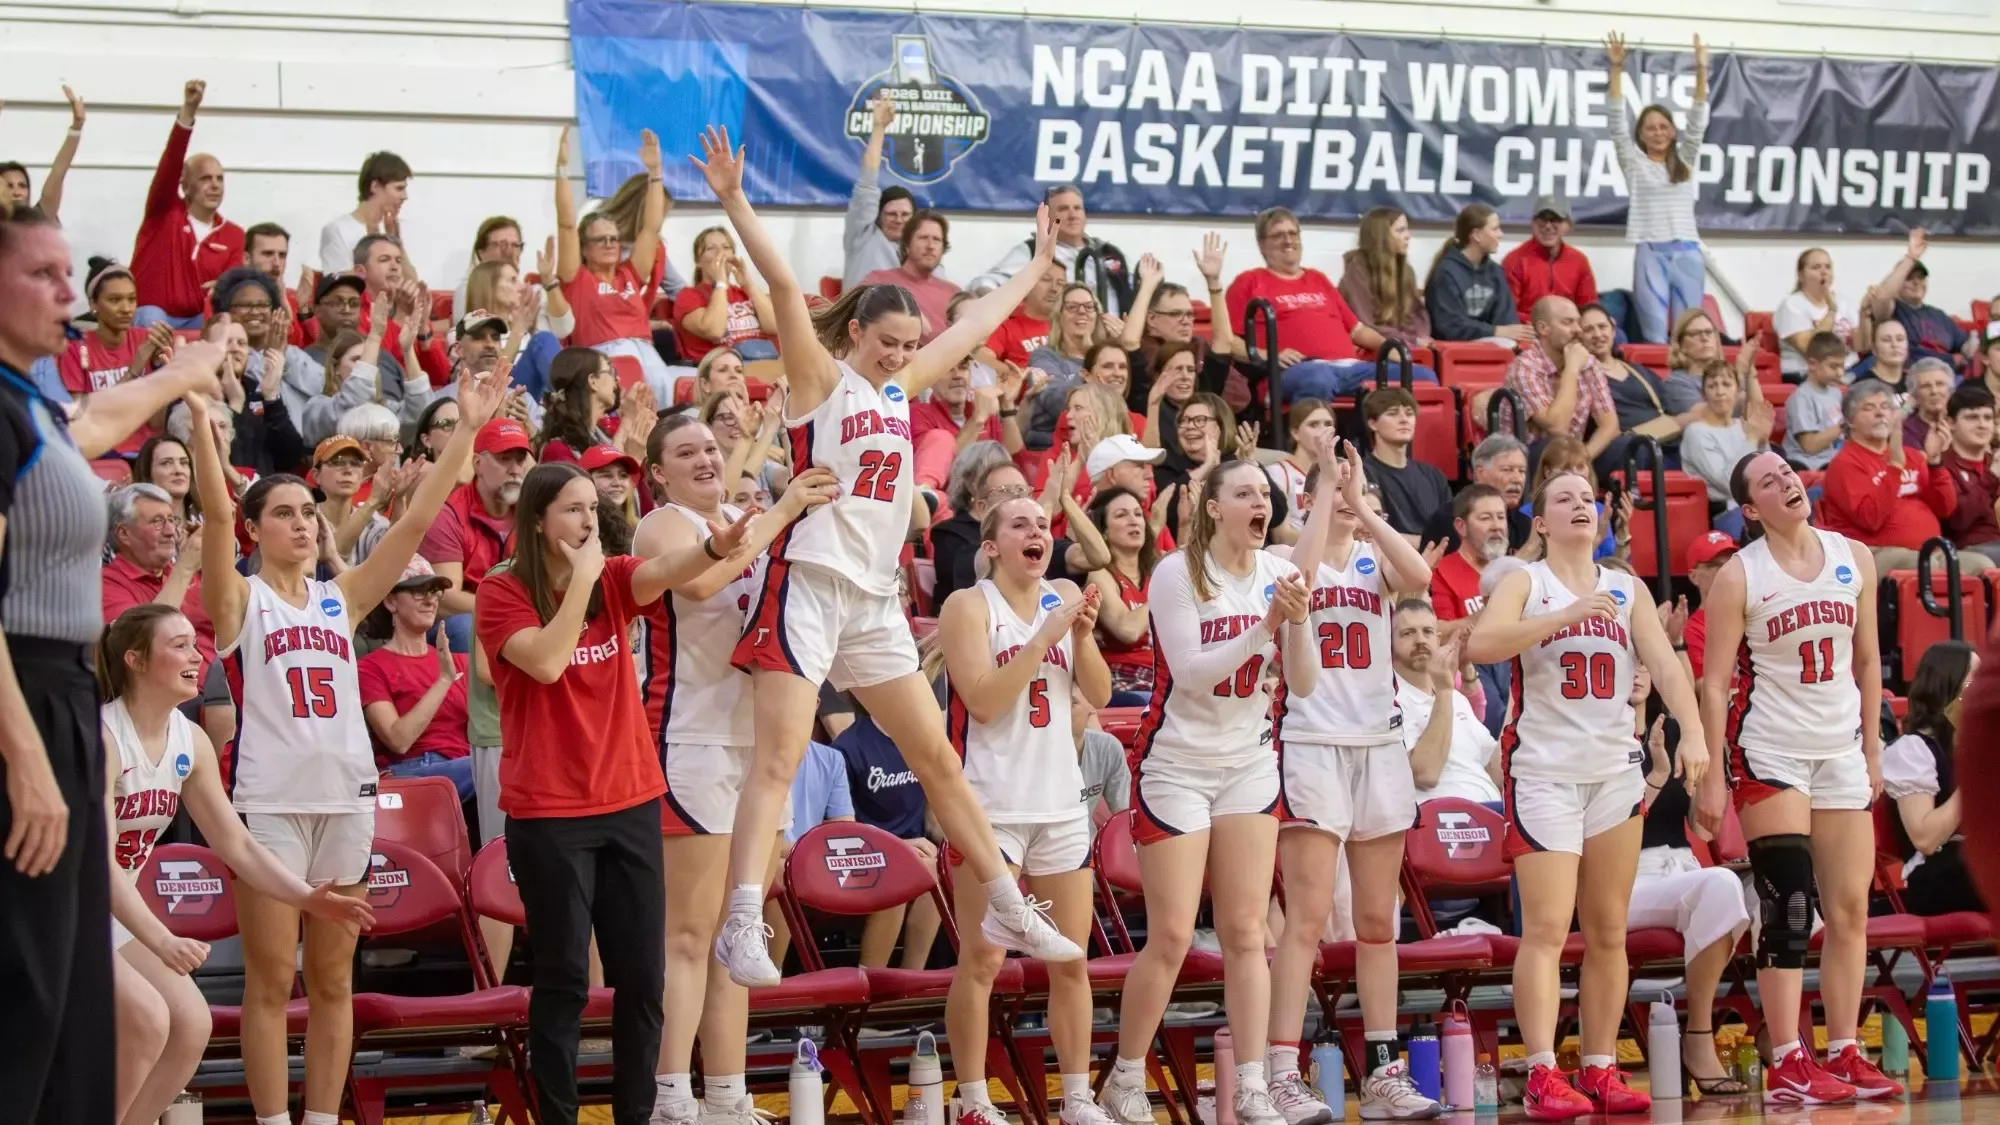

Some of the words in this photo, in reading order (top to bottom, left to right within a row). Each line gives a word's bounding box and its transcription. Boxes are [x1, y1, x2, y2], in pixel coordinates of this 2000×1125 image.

[922, 89, 953, 101] DIII
[1031, 44, 1223, 112] NCAA
[1240, 53, 1388, 119] DIII
[850, 111, 985, 136] CHMPIONSHIP
[1033, 118, 1473, 196] BASKETBALL
[1493, 135, 1991, 210] CHAPIONSHIP
[840, 408, 911, 445] DENSO
[851, 449, 902, 502] 22
[1309, 586, 1382, 617] ENISON
[1766, 600, 1854, 643] DENISON
[264, 625, 350, 665] DENISON
[1318, 621, 1372, 669] 20
[1798, 637, 1834, 684] 11
[286, 667, 338, 718] 15
[1560, 651, 1615, 700] 30
[1029, 678, 1051, 728] 5
[114, 788, 179, 820] DENISO
[386, 795, 394, 806] 7
[115, 828, 158, 870] 21
[1439, 829, 1487, 841] DENISON
[829, 855, 882, 868] DENISON
[160, 880, 220, 893] DENISON
